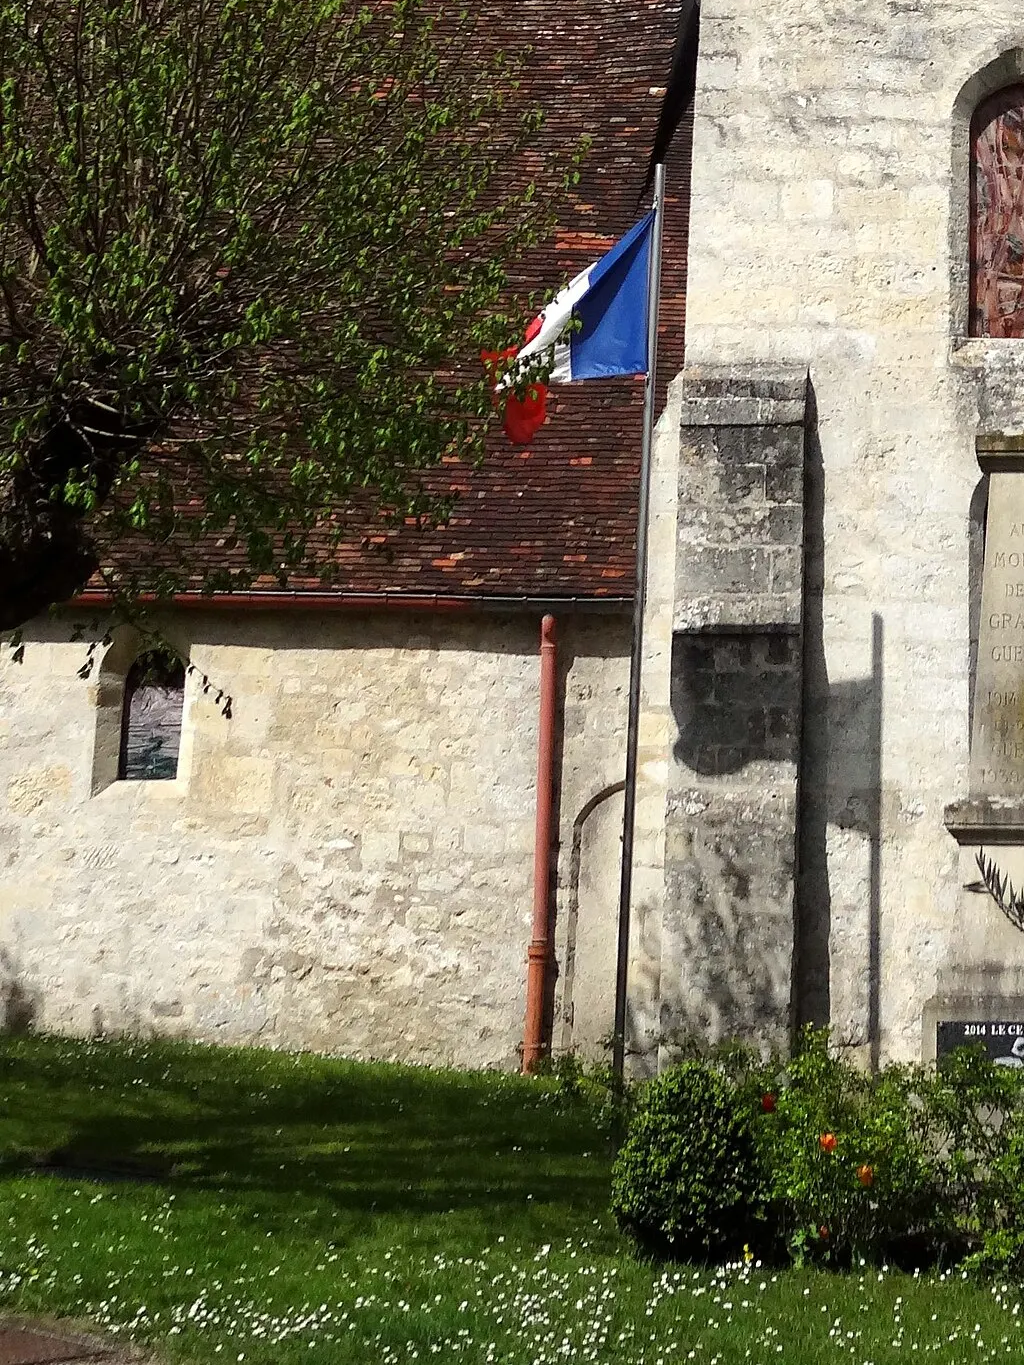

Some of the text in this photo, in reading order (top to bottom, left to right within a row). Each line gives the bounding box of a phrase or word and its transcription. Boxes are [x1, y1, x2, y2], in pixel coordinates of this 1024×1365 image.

[1004, 582, 1024, 598] DE
[964, 1024, 986, 1035] 2014
[991, 1024, 1006, 1035] LE
